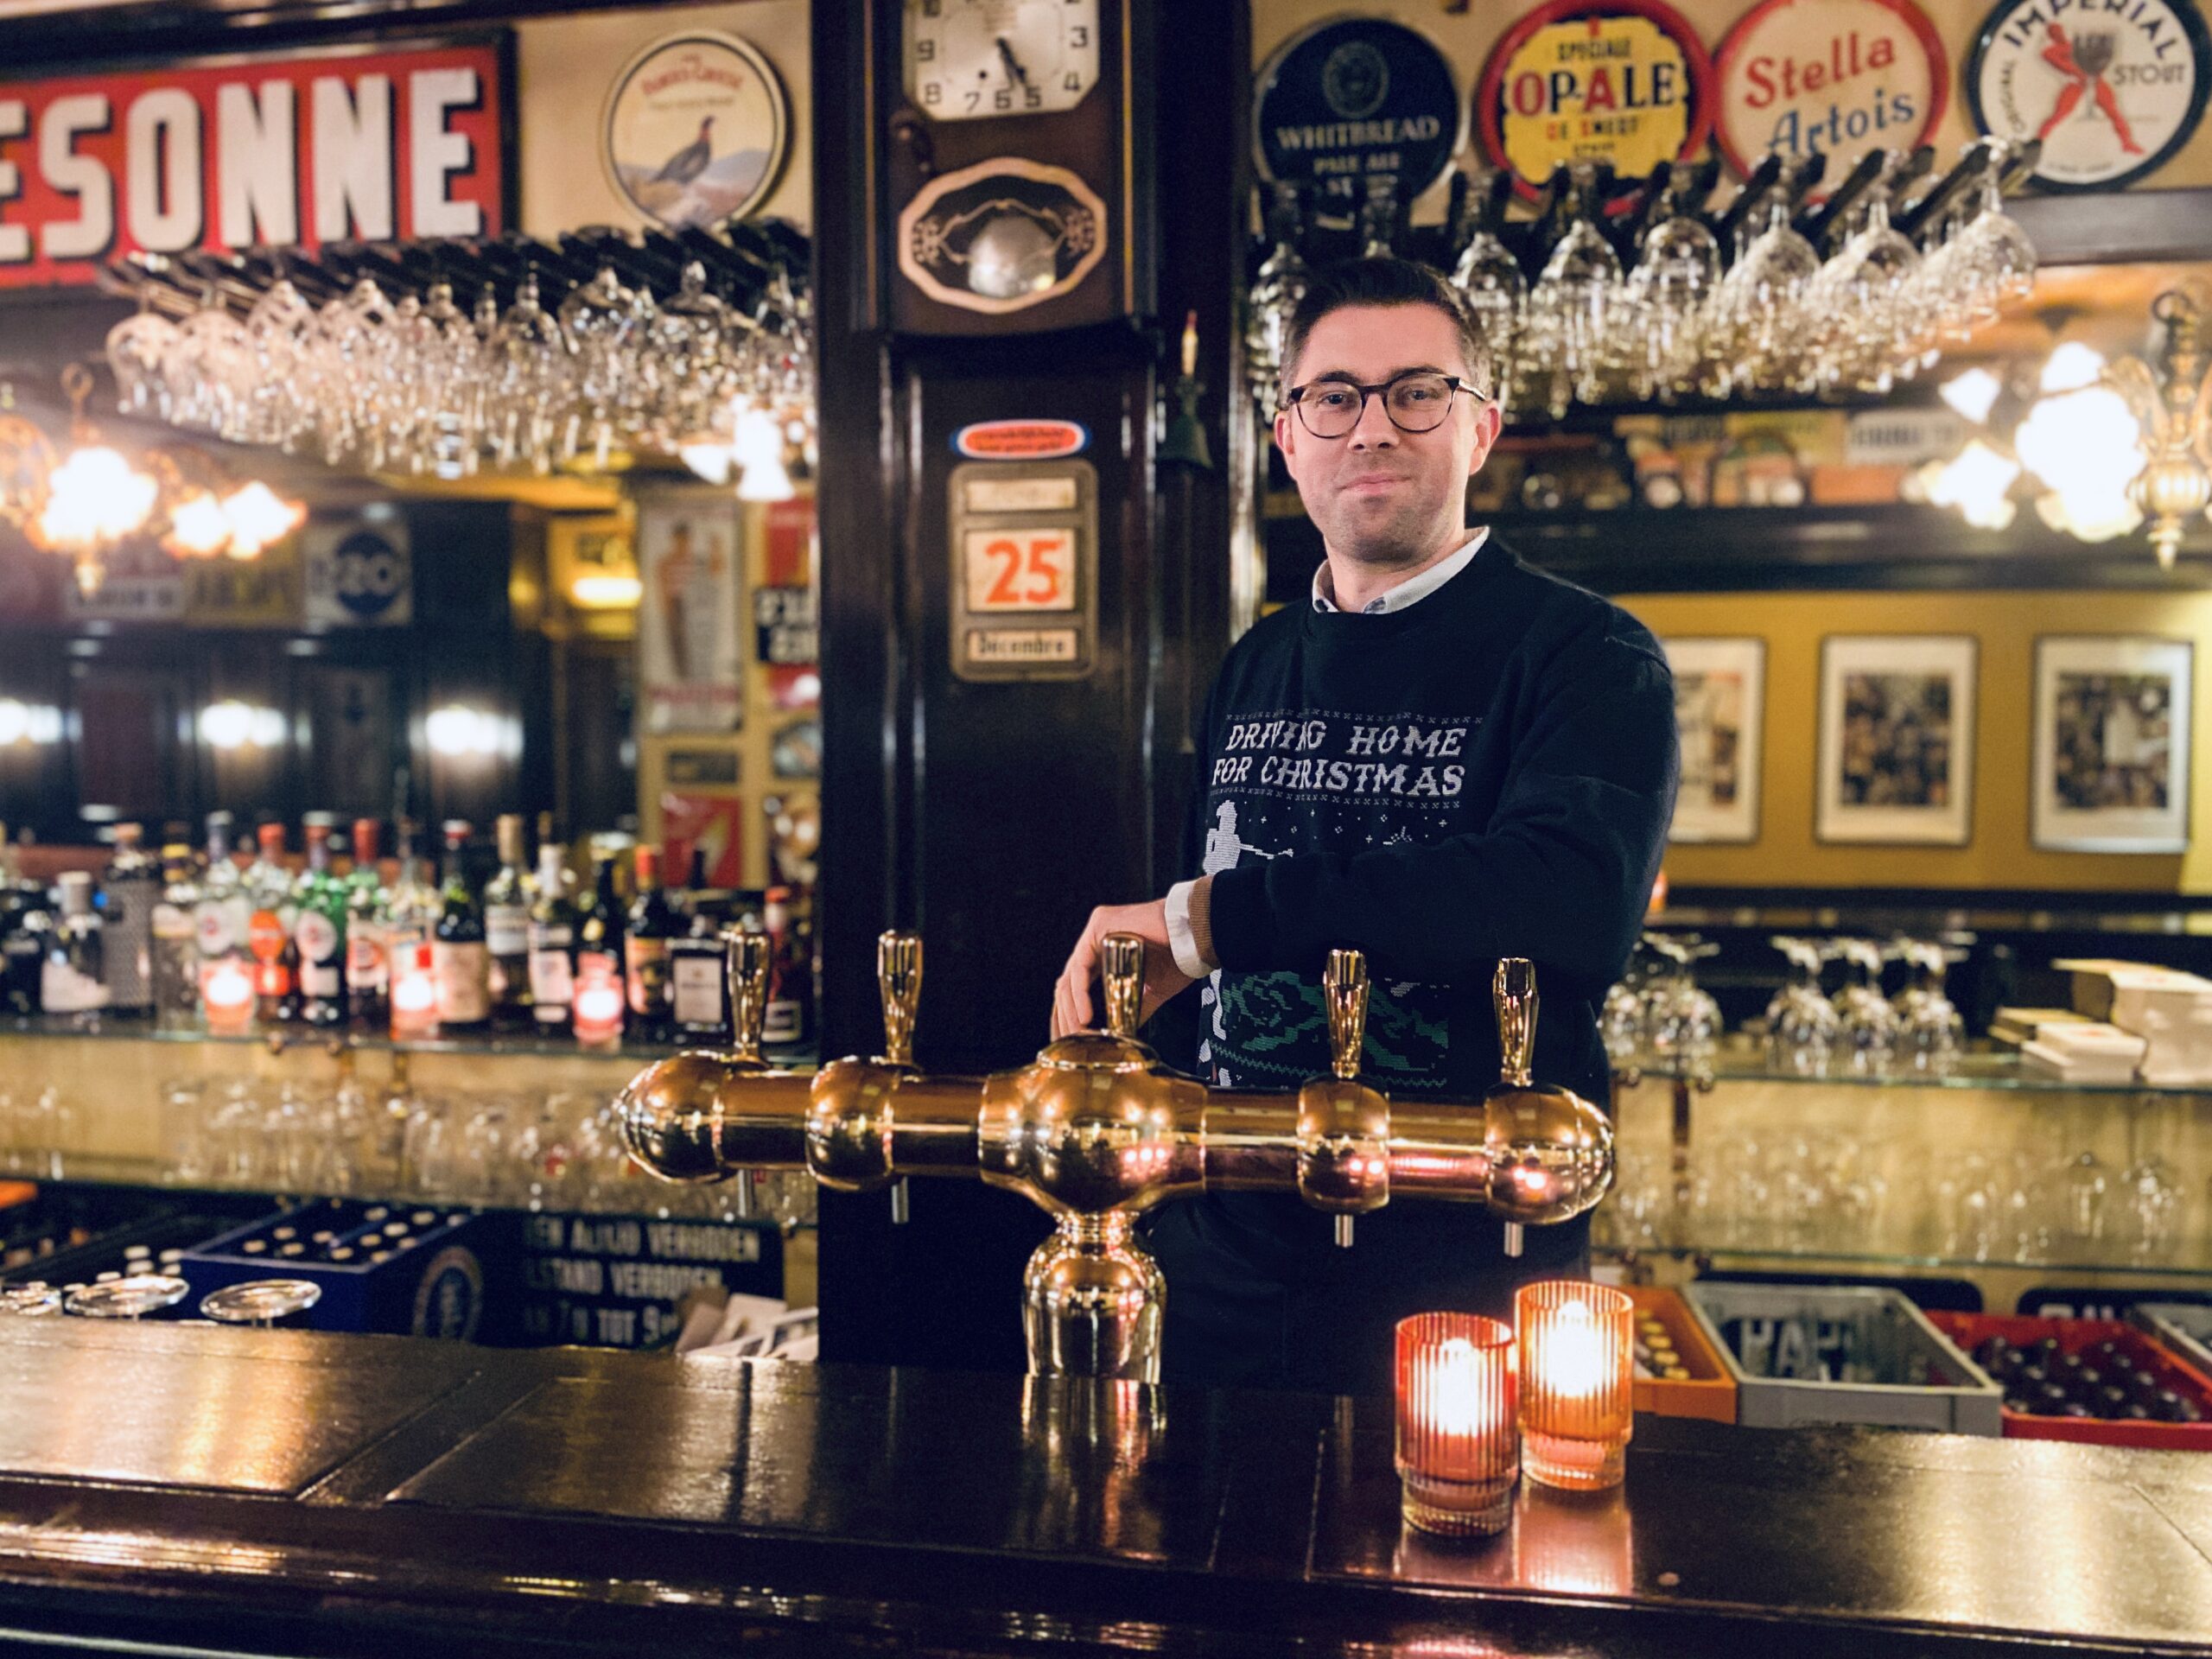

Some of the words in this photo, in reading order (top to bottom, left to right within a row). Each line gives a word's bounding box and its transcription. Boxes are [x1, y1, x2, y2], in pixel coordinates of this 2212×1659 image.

[1071, 27, 1088, 48] 3
[918, 40, 935, 61] 9
[1744, 31, 1896, 111] Stella
[2114, 65, 2185, 86] STOUT
[1064, 72, 1080, 92] 4
[925, 85, 941, 105] 8
[964, 92, 980, 111] 7
[995, 89, 1011, 109] 6
[1025, 86, 1041, 108] 5
[1766, 88, 1915, 154] Artois
[1276, 114, 1441, 151] WHITBREAD
[984, 539, 1065, 604] 25
[1224, 720, 1326, 752] DRIVING
[1345, 725, 1467, 758] HOME
[1211, 755, 1253, 785] FOR
[1261, 755, 1466, 797] CHRISTMAS
